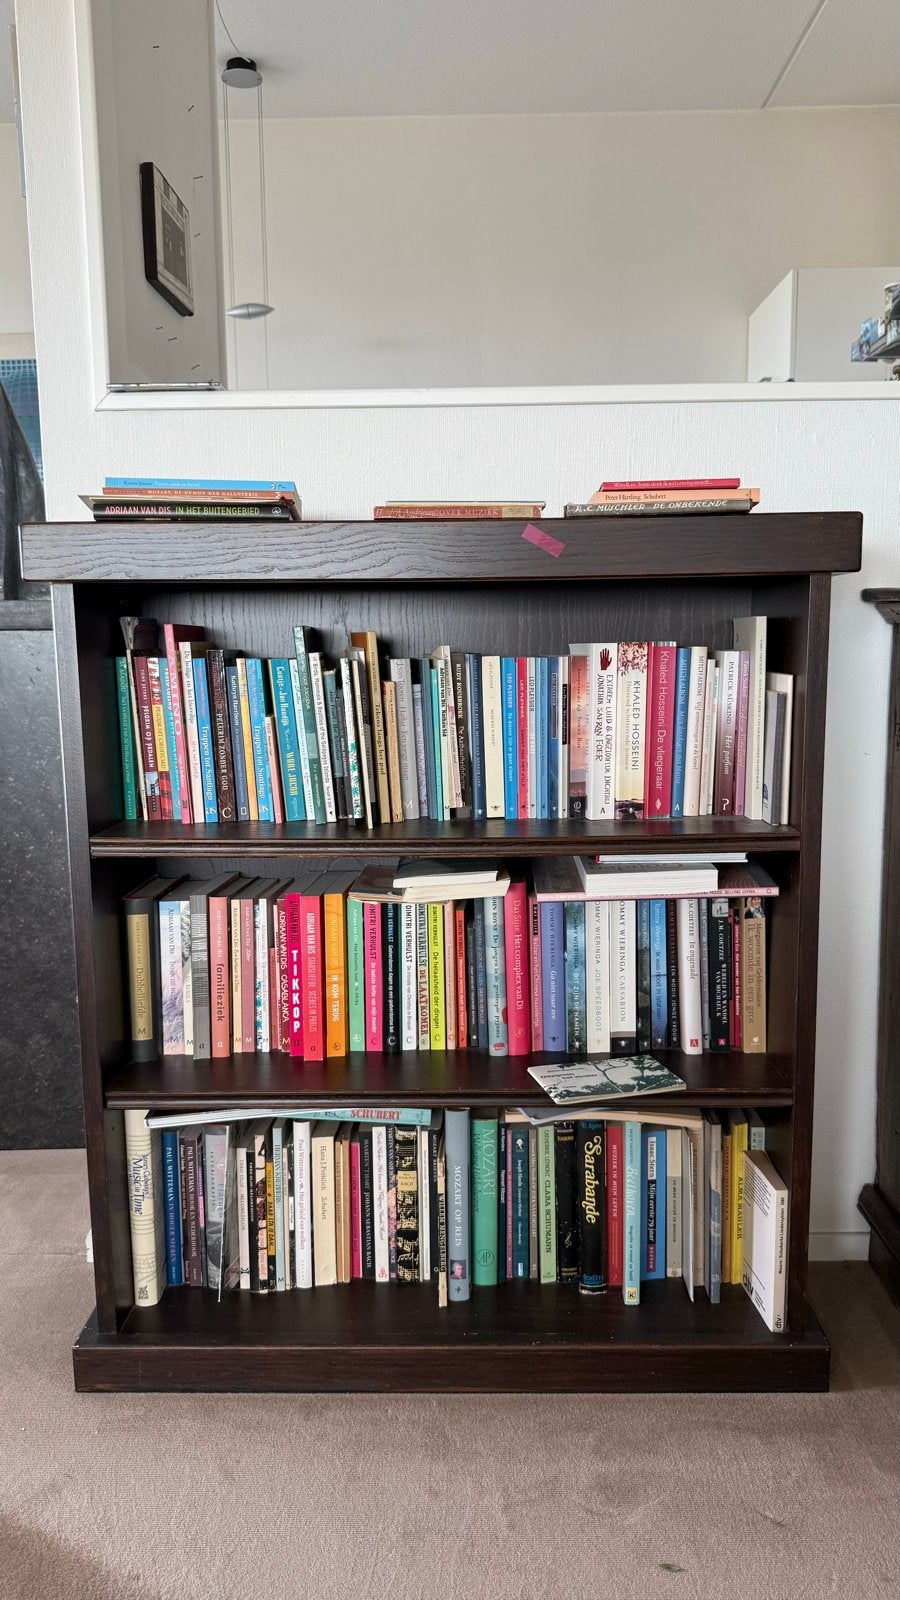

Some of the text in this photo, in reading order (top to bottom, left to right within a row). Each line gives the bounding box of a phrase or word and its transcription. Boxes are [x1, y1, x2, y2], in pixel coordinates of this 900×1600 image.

[105, 506, 139, 514] ADRIAAN
[185, 651, 192, 659] De
[184, 660, 193, 680] heilige
[632, 681, 641, 719] KHALED
[726, 694, 735, 725] SÜSKIND
[216, 713, 224, 744] PELGRIM
[459, 726, 464, 734] De
[594, 708, 603, 736] SAFRAN
[655, 651, 669, 790] Khaled Hosseini De vliegeraar
[595, 739, 603, 761] FOER
[725, 735, 733, 748] Het
[723, 750, 732, 774] parfum
[205, 769, 213, 800] Santiago
[257, 768, 265, 798] Santiago
[748, 924, 755, 932] Ik
[433, 952, 439, 960] De
[514, 949, 522, 984] complex
[419, 970, 427, 980] DE
[550, 971, 556, 979] Ga
[748, 974, 755, 984] in
[136, 968, 145, 1019] Dubbelliefde
[216, 963, 225, 1022] familieziek
[281, 975, 289, 1022] CASABLANCA
[292, 950, 300, 1032] TIKKOP
[419, 981, 428, 1036] LAATKOMER
[574, 1002, 580, 1010] DE
[747, 1006, 755, 1024] grot
[350, 1108, 401, 1120] SCHUBERT
[482, 1128, 496, 1199] MOZART
[612, 1170, 617, 1179] IN
[132, 1158, 144, 1215] Music Time
[582, 1136, 601, 1223] Sarabande
[648, 1183, 656, 1199] Mijn
[626, 1166, 638, 1218] Beethoven
[455, 1210, 462, 1223] OP
[648, 1218, 655, 1227] 79
